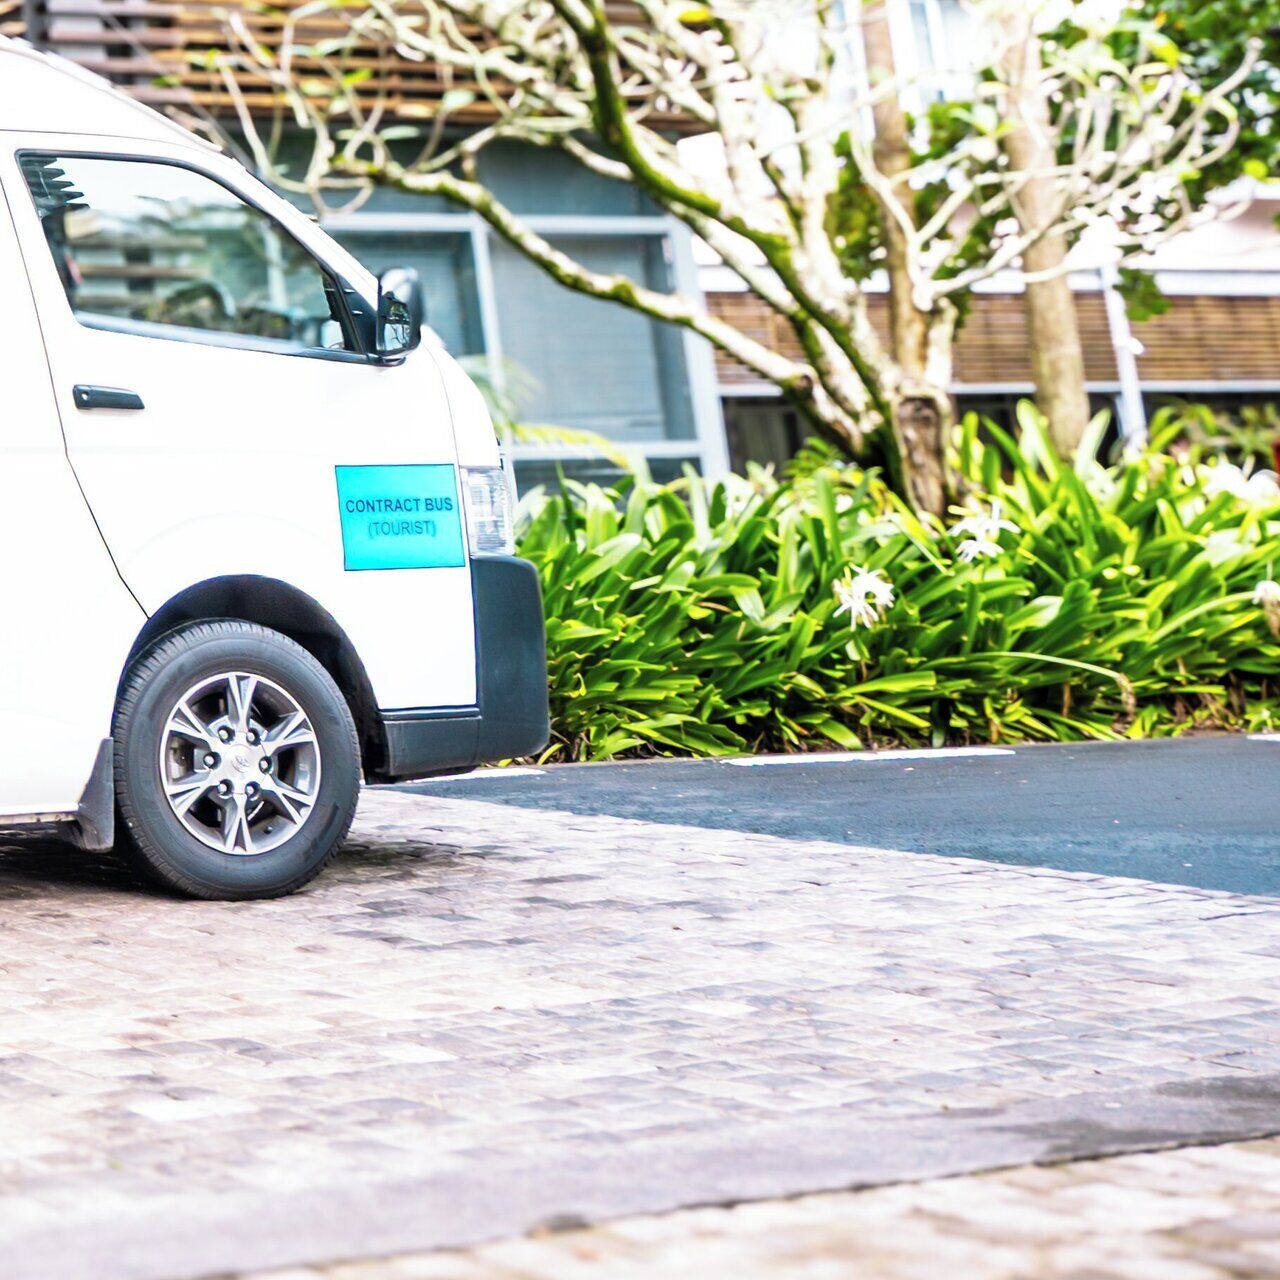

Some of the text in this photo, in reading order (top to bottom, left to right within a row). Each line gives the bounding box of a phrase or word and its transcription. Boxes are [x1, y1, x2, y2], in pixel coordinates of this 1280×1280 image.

[345, 497, 454, 514] CONTRACT BUS
[368, 520, 437, 539] (TOURIST)
